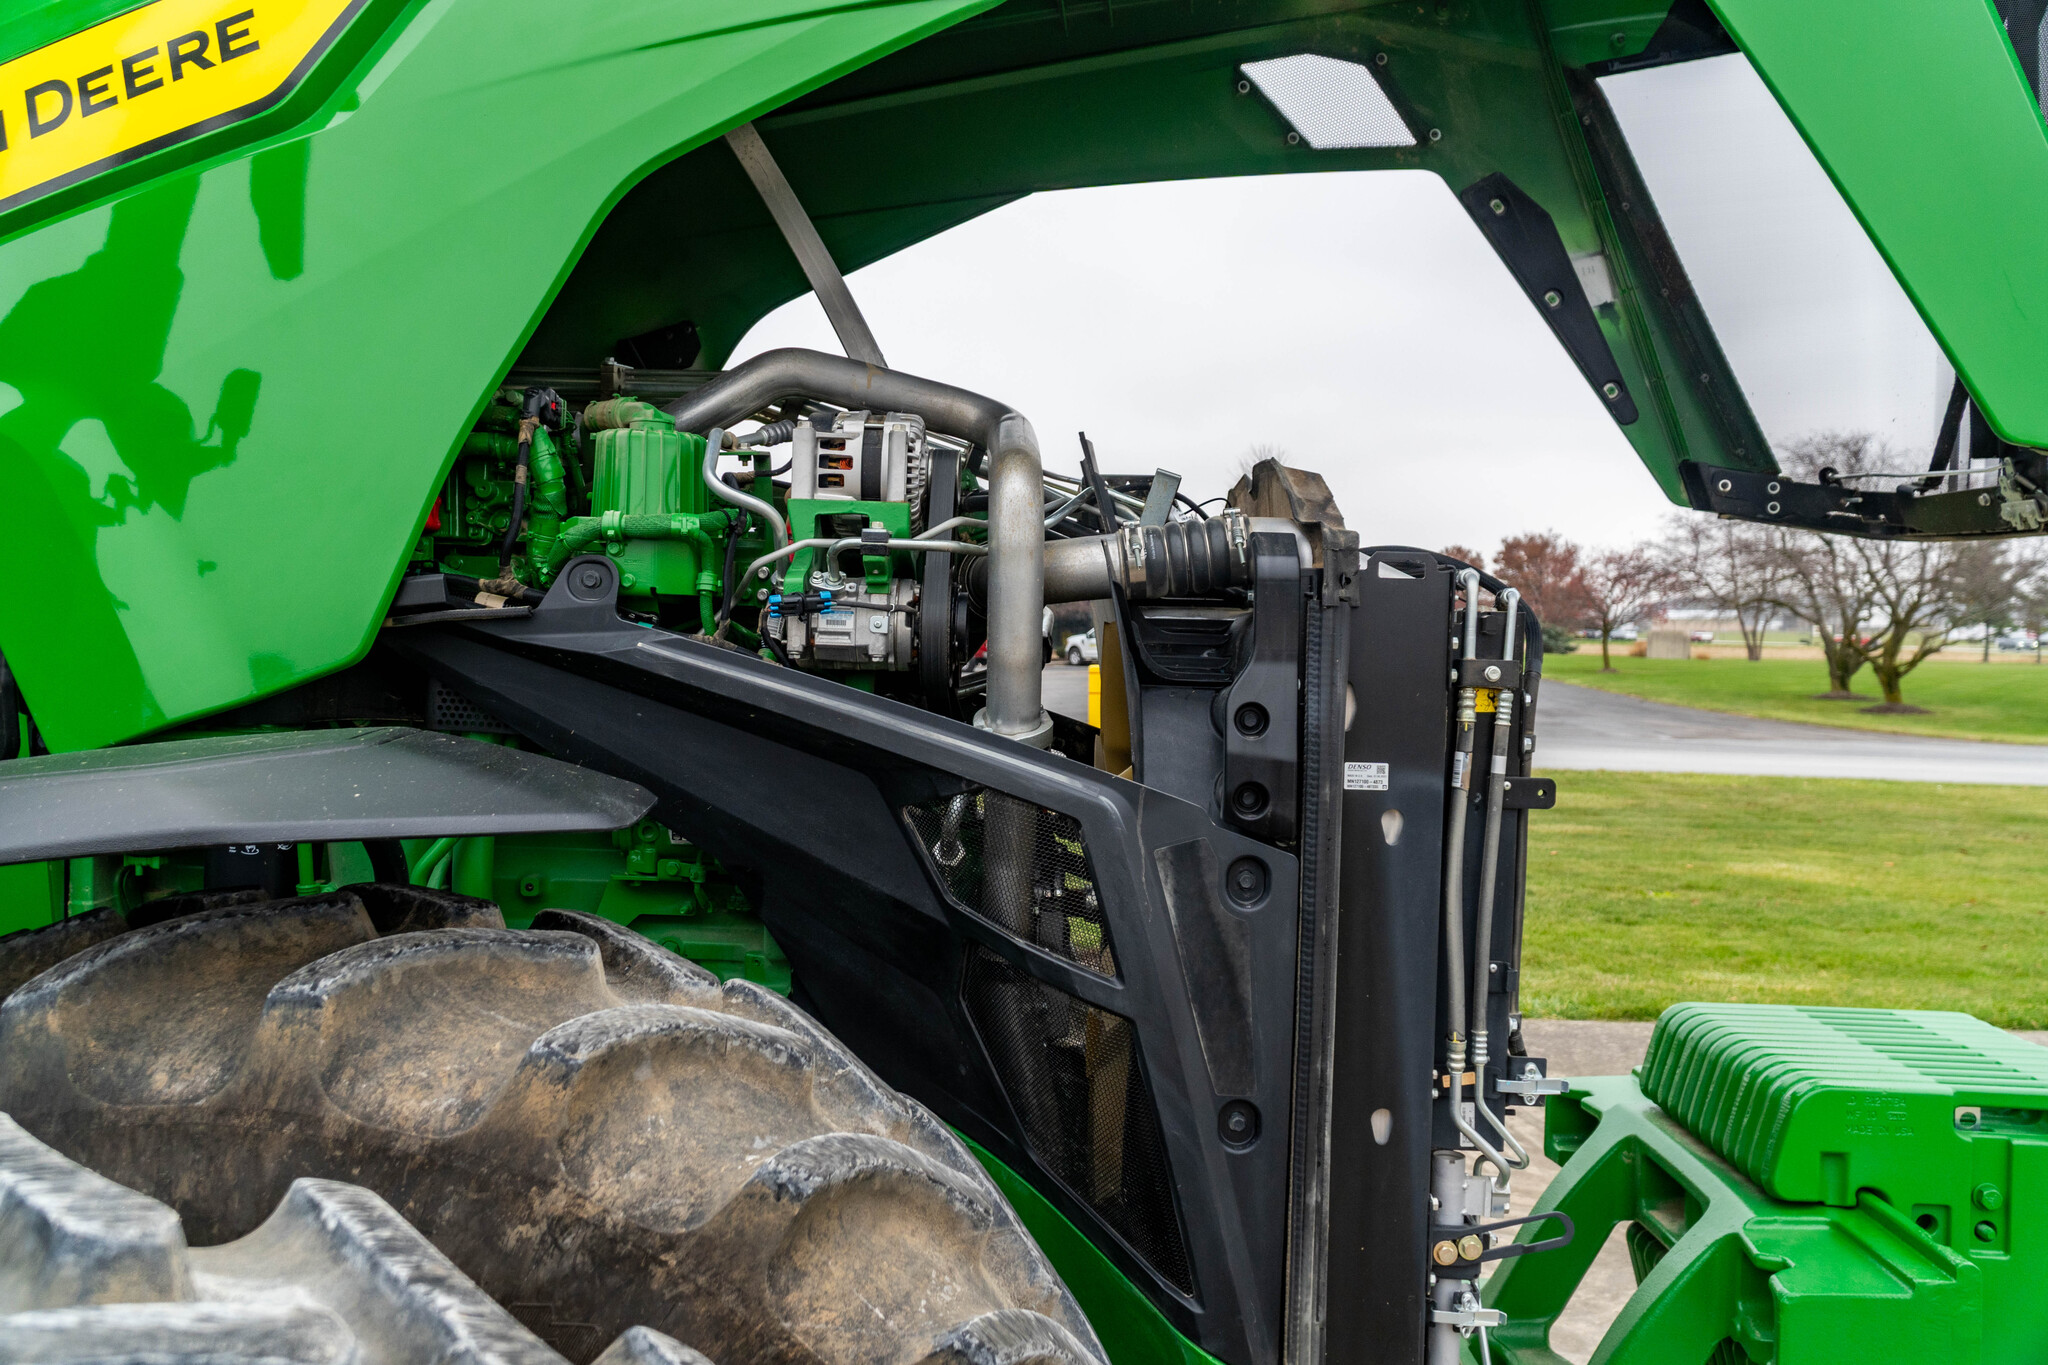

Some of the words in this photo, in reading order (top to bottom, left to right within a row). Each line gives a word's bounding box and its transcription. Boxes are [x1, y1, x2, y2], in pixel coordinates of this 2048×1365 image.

[24, 8, 260, 140] DEERE
[1845, 1124, 1873, 1136] MADE
[1895, 1126, 1915, 1137] USA
